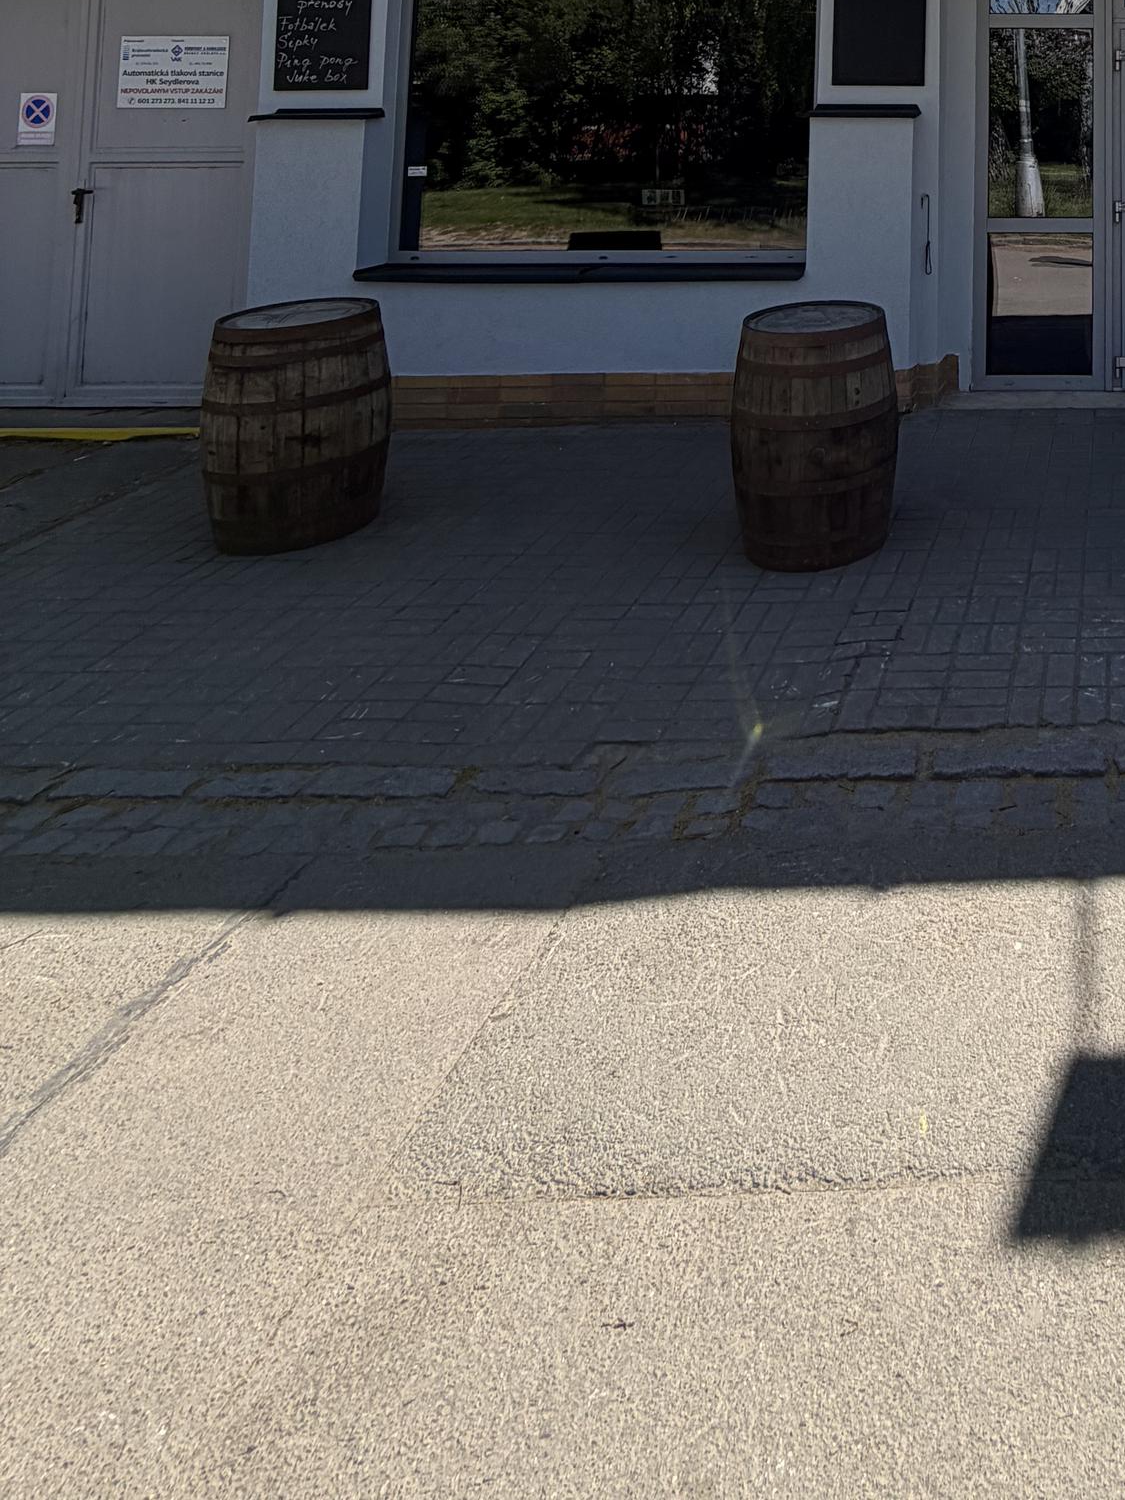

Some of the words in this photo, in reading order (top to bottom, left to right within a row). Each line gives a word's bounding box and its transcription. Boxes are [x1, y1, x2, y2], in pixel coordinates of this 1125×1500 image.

[278, 15, 337, 33] Fotbálek
[277, 31, 319, 52] Šipky
[276, 52, 312, 71] Ping
[319, 55, 359, 71] pong
[122, 69, 169, 77] Automatická
[170, 69, 197, 77] tlaková
[198, 69, 225, 77] stanice
[286, 69, 318, 84] Juke
[324, 69, 348, 84] box
[159, 77, 200, 86] Seydlerova
